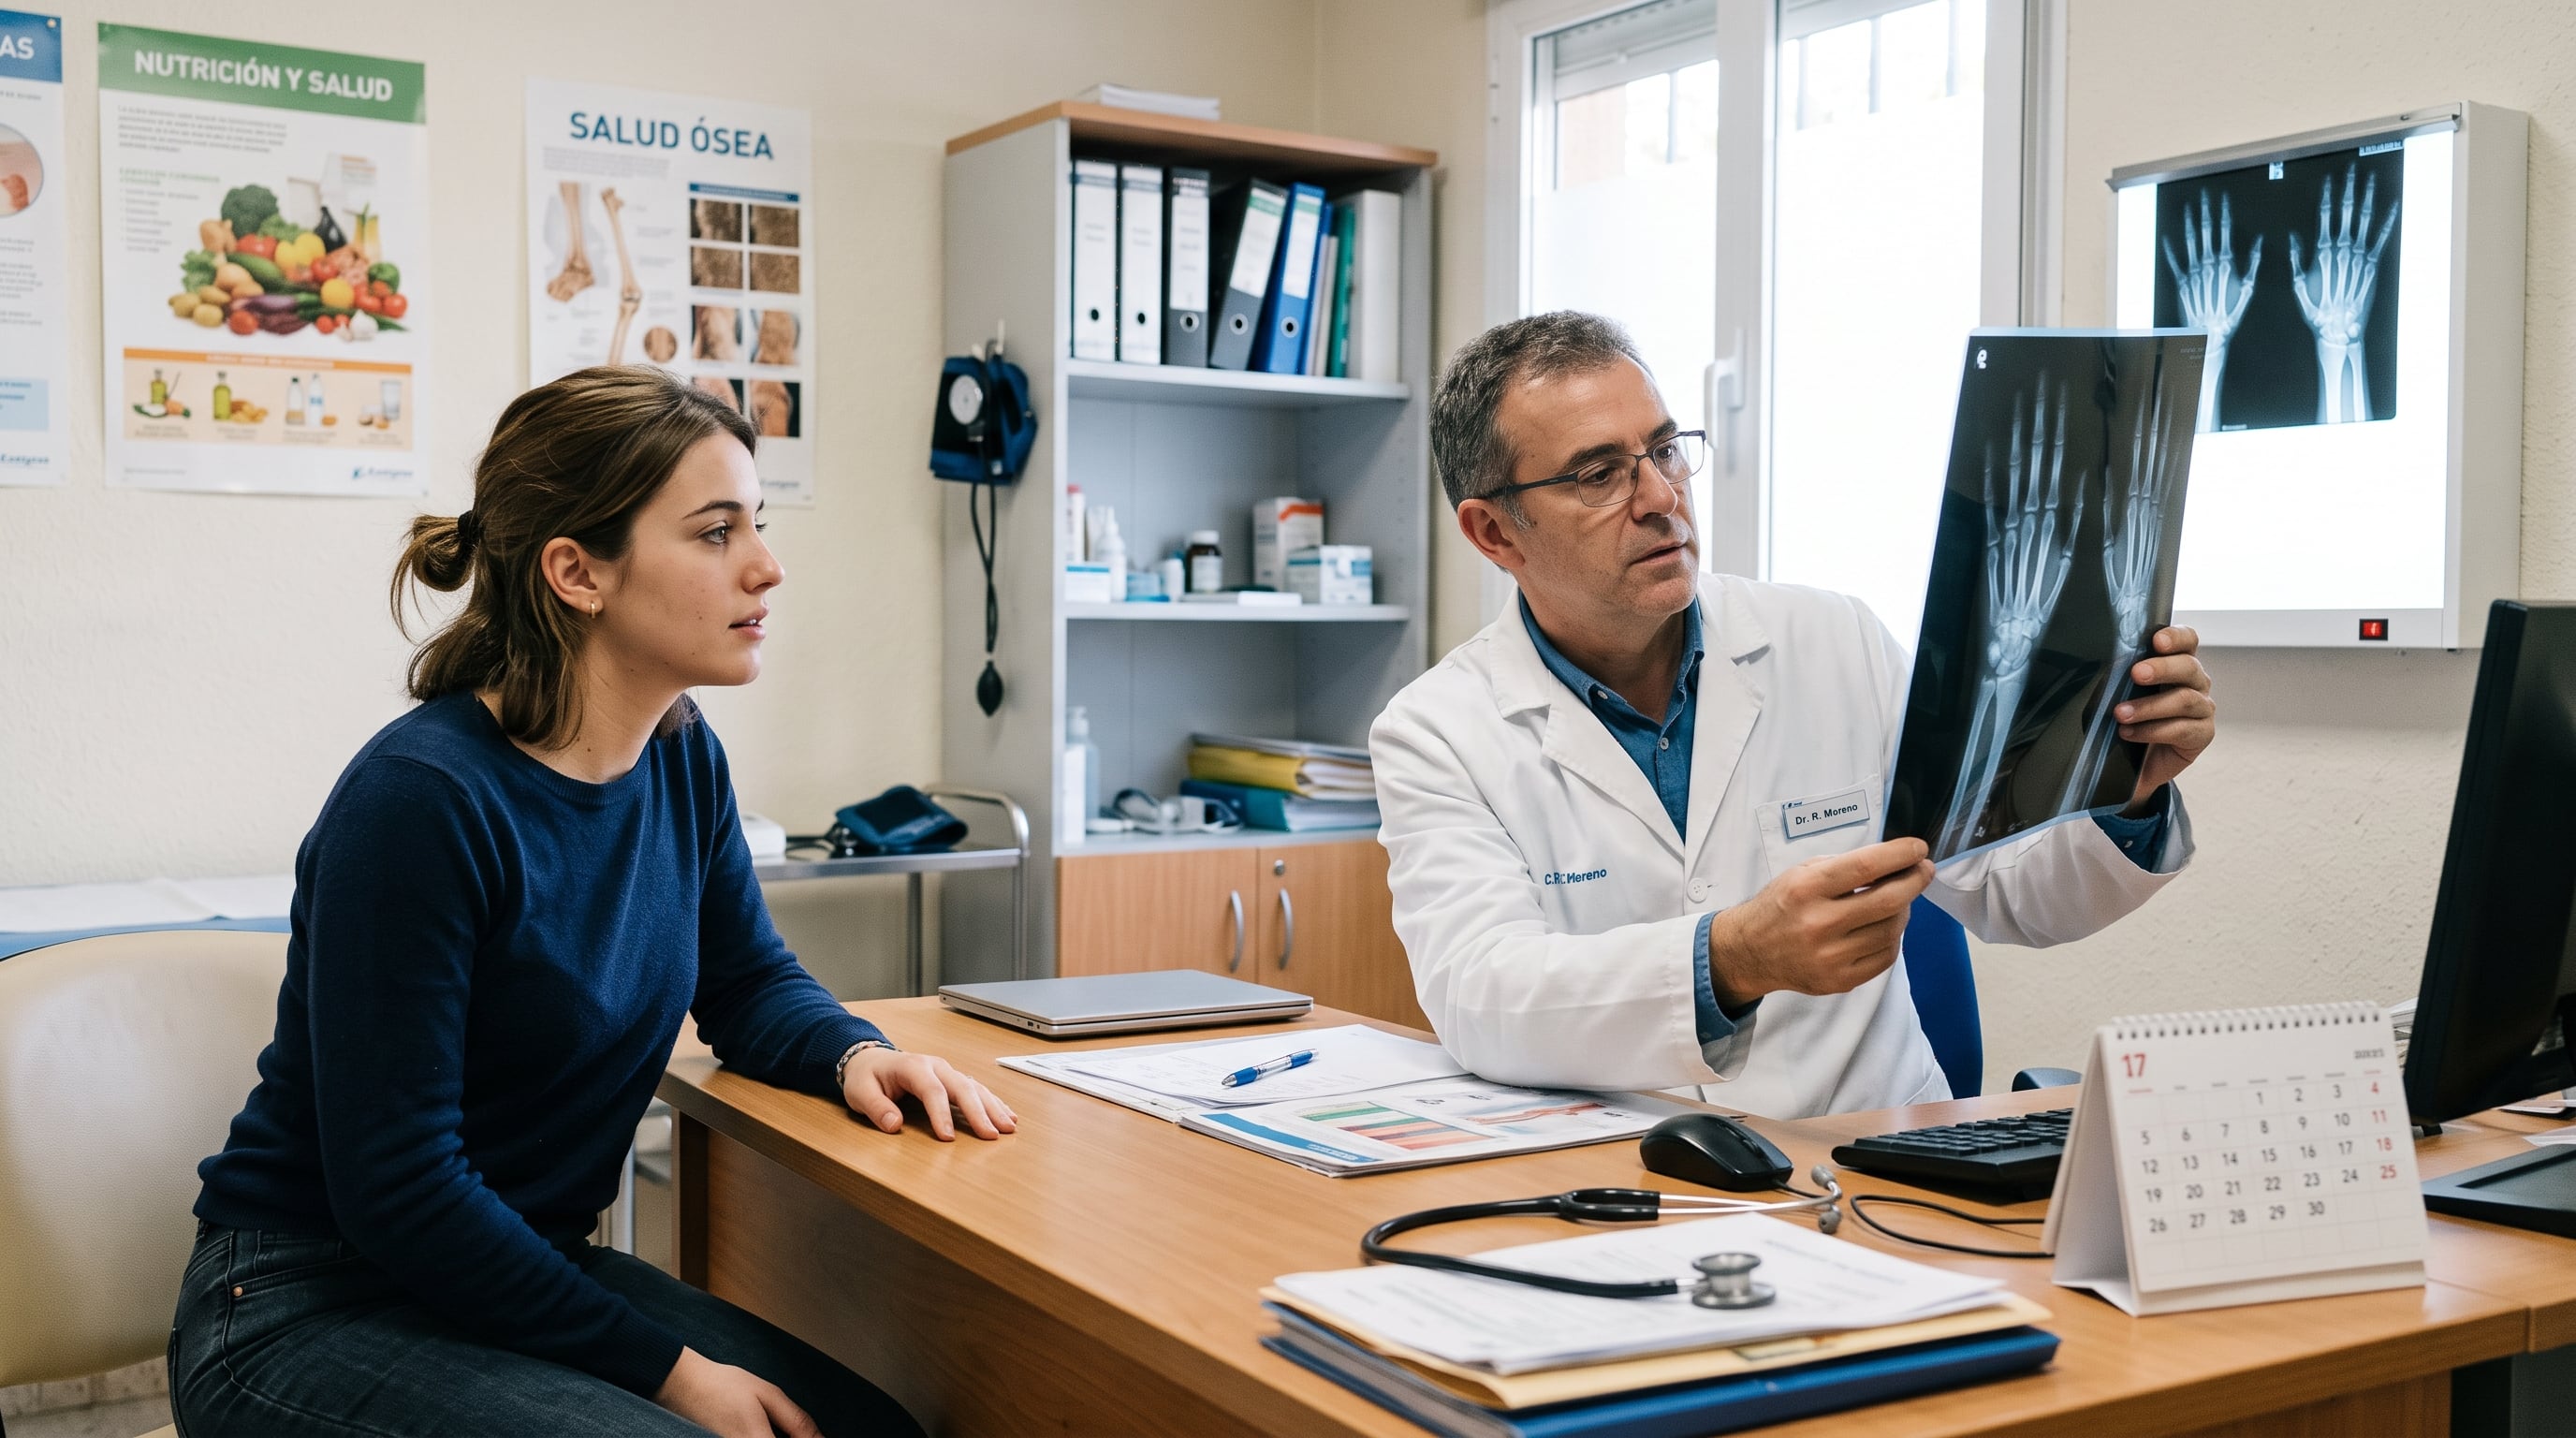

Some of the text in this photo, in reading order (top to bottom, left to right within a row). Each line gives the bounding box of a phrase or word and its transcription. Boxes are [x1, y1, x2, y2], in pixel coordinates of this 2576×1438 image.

[0, 34, 35, 60] AS
[134, 50, 393, 102] NUTRICIÓN Y SALUD
[569, 110, 775, 161] SALUD ÓSEA
[1795, 804, 1858, 825] Dr. R. Moreno
[2121, 1052, 2146, 1078] 17
[2256, 1080, 2380, 1106] 1 2 3 4
[2141, 1108, 2387, 1146] 5 6 7 8 9 10 11
[2142, 1137, 2393, 1174] 12 13 14 15 16 17 18
[2145, 1164, 2397, 1203] 19 20 21 22 23 24 25
[2149, 1200, 2325, 1234] 26 27 28 29 30
